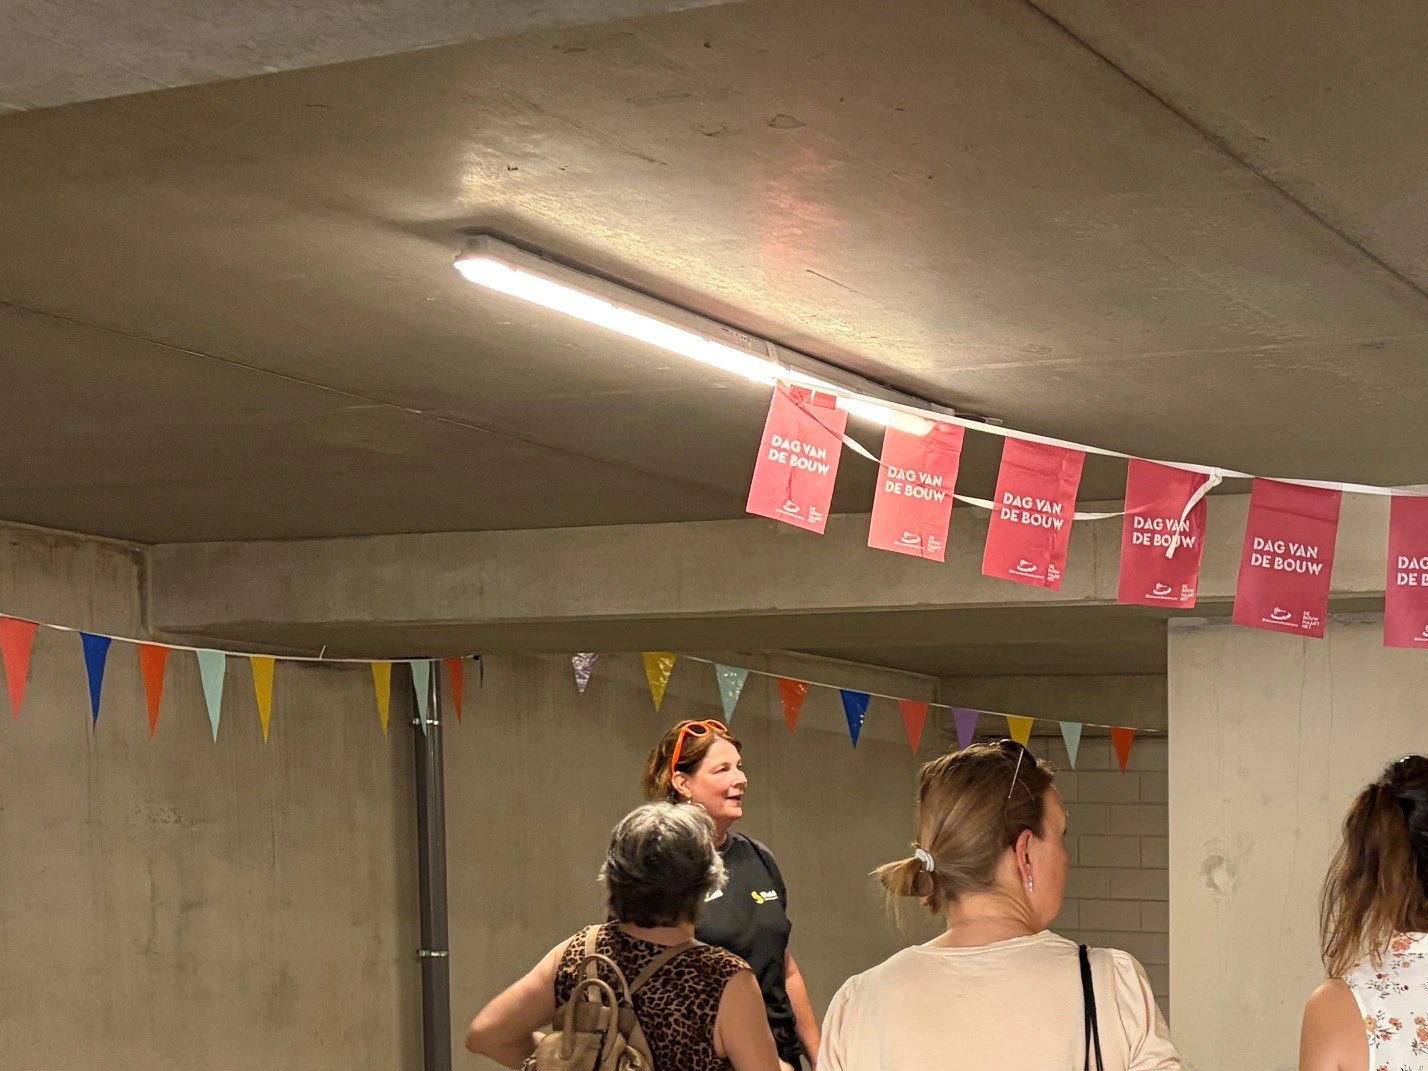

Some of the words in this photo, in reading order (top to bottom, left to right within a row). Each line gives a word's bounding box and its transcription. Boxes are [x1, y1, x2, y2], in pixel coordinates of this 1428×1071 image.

[771, 434, 801, 453] DAG
[803, 443, 827, 460] VAN
[768, 448, 788, 464] DE
[789, 454, 830, 476] BOUW
[887, 466, 916, 482] DAG
[918, 472, 943, 487] VAN
[885, 480, 903, 495] DE
[904, 484, 946, 503] BOUW
[1003, 492, 1033, 509] DAG
[1036, 499, 1062, 515] VAN
[1000, 507, 1019, 522] DE
[1021, 511, 1064, 531] BOUW
[1134, 516, 1163, 530] DAG
[1166, 518, 1190, 532] VAN
[1132, 531, 1151, 546] DE
[1253, 537, 1285, 553] DAG
[1289, 542, 1318, 558] VAN
[1251, 553, 1271, 568] DE
[1274, 557, 1323, 575] BOUW
[1397, 572, 1417, 585] DE
